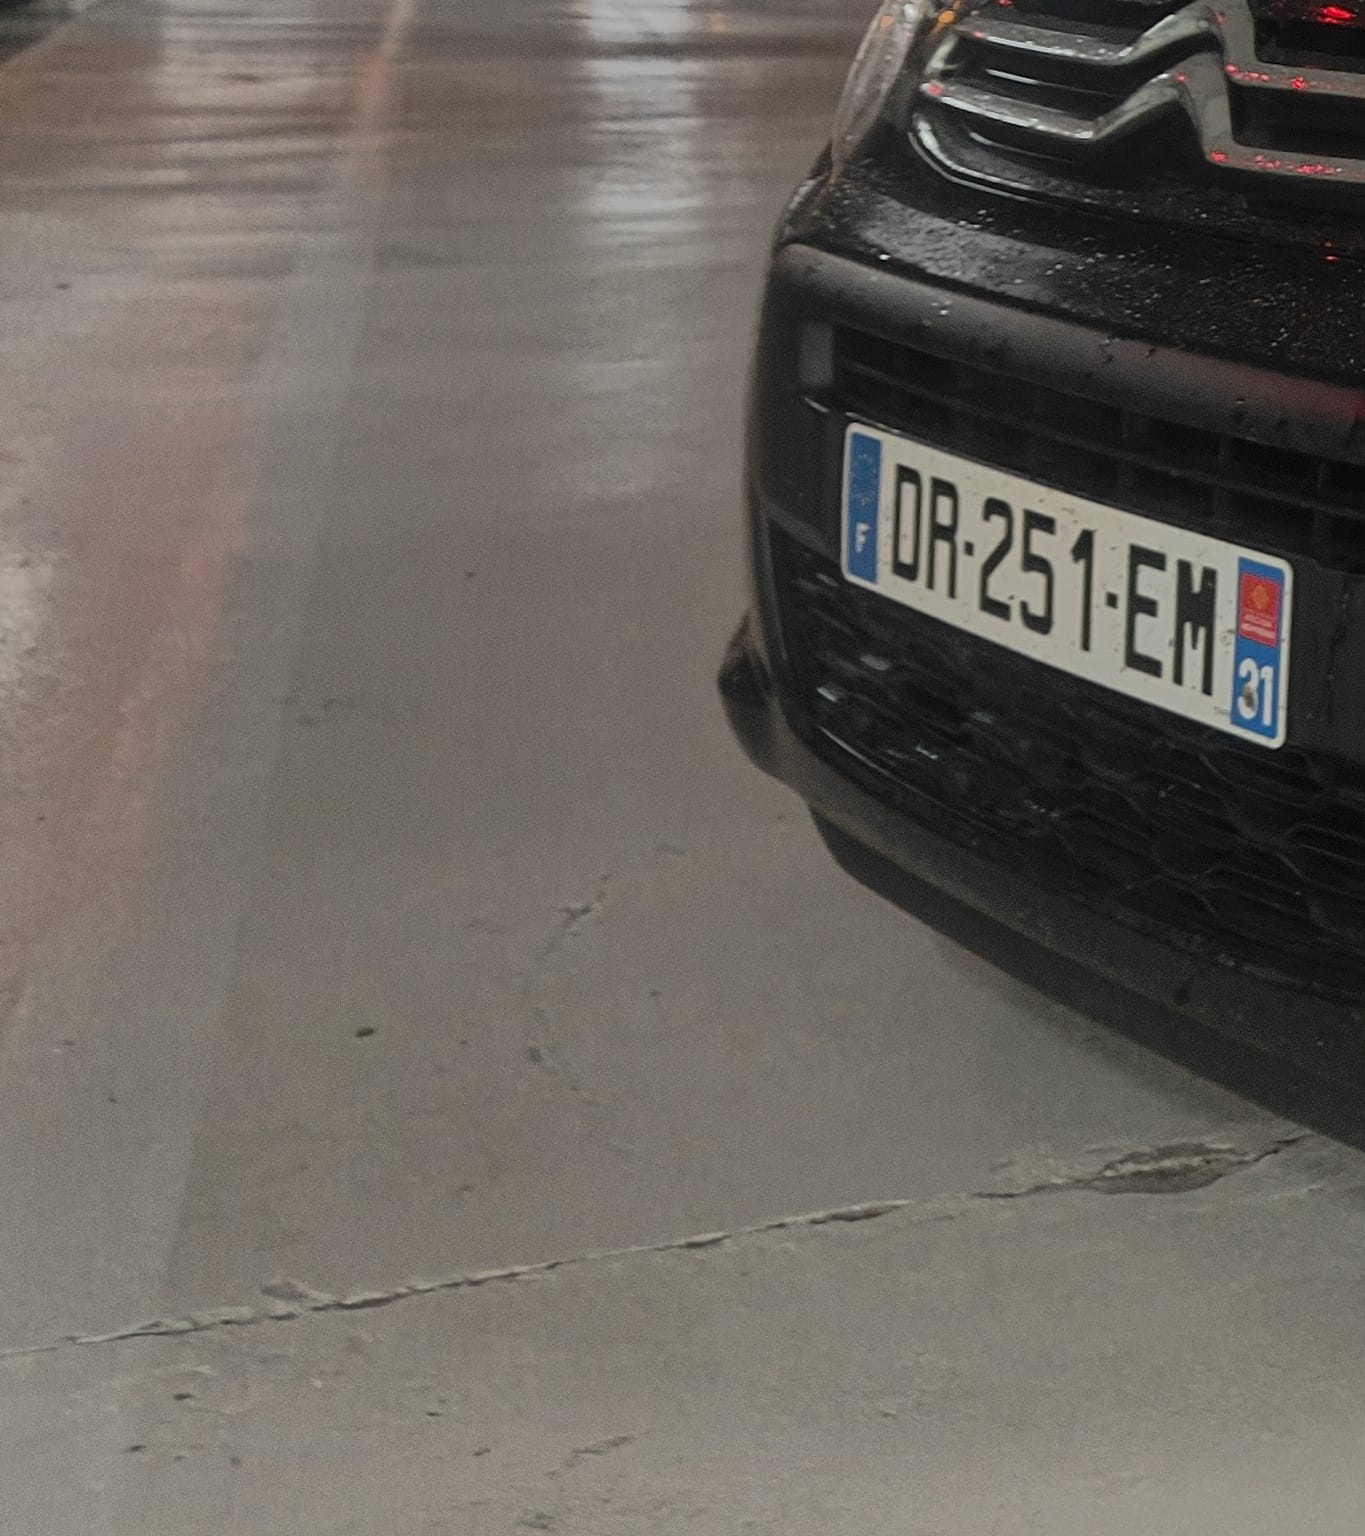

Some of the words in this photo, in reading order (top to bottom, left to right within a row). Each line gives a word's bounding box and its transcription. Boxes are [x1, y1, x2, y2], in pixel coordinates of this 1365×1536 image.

[856, 522, 870, 553] F
[892, 463, 1218, 697] DR-251-EM
[1237, 657, 1275, 727] 31
